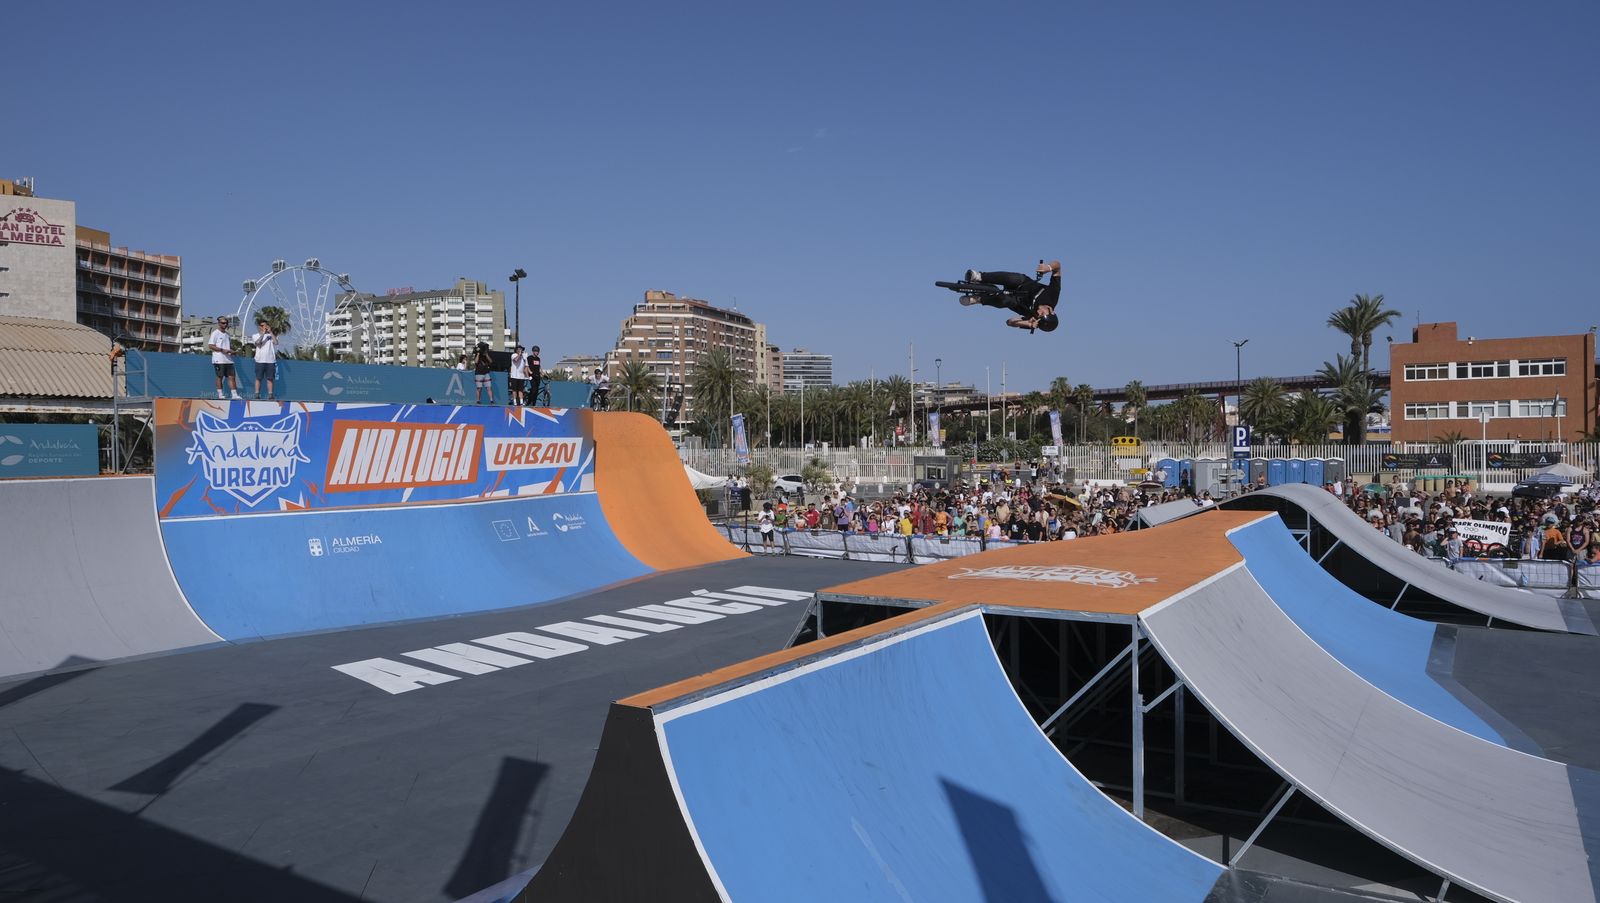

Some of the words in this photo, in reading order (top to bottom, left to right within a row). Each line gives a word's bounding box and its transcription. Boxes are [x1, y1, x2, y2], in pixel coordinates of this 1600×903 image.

[26, 224, 65, 236] HOTEL
[1236, 427, 1247, 446] P
[187, 432, 310, 464] Andalucía
[329, 423, 478, 486] ANDALUCÍA
[493, 442, 577, 466] URBAN
[212, 466, 289, 488] URBAN
[332, 533, 382, 547] ALMERÍA
[330, 585, 815, 695] ANDALUCÍA
